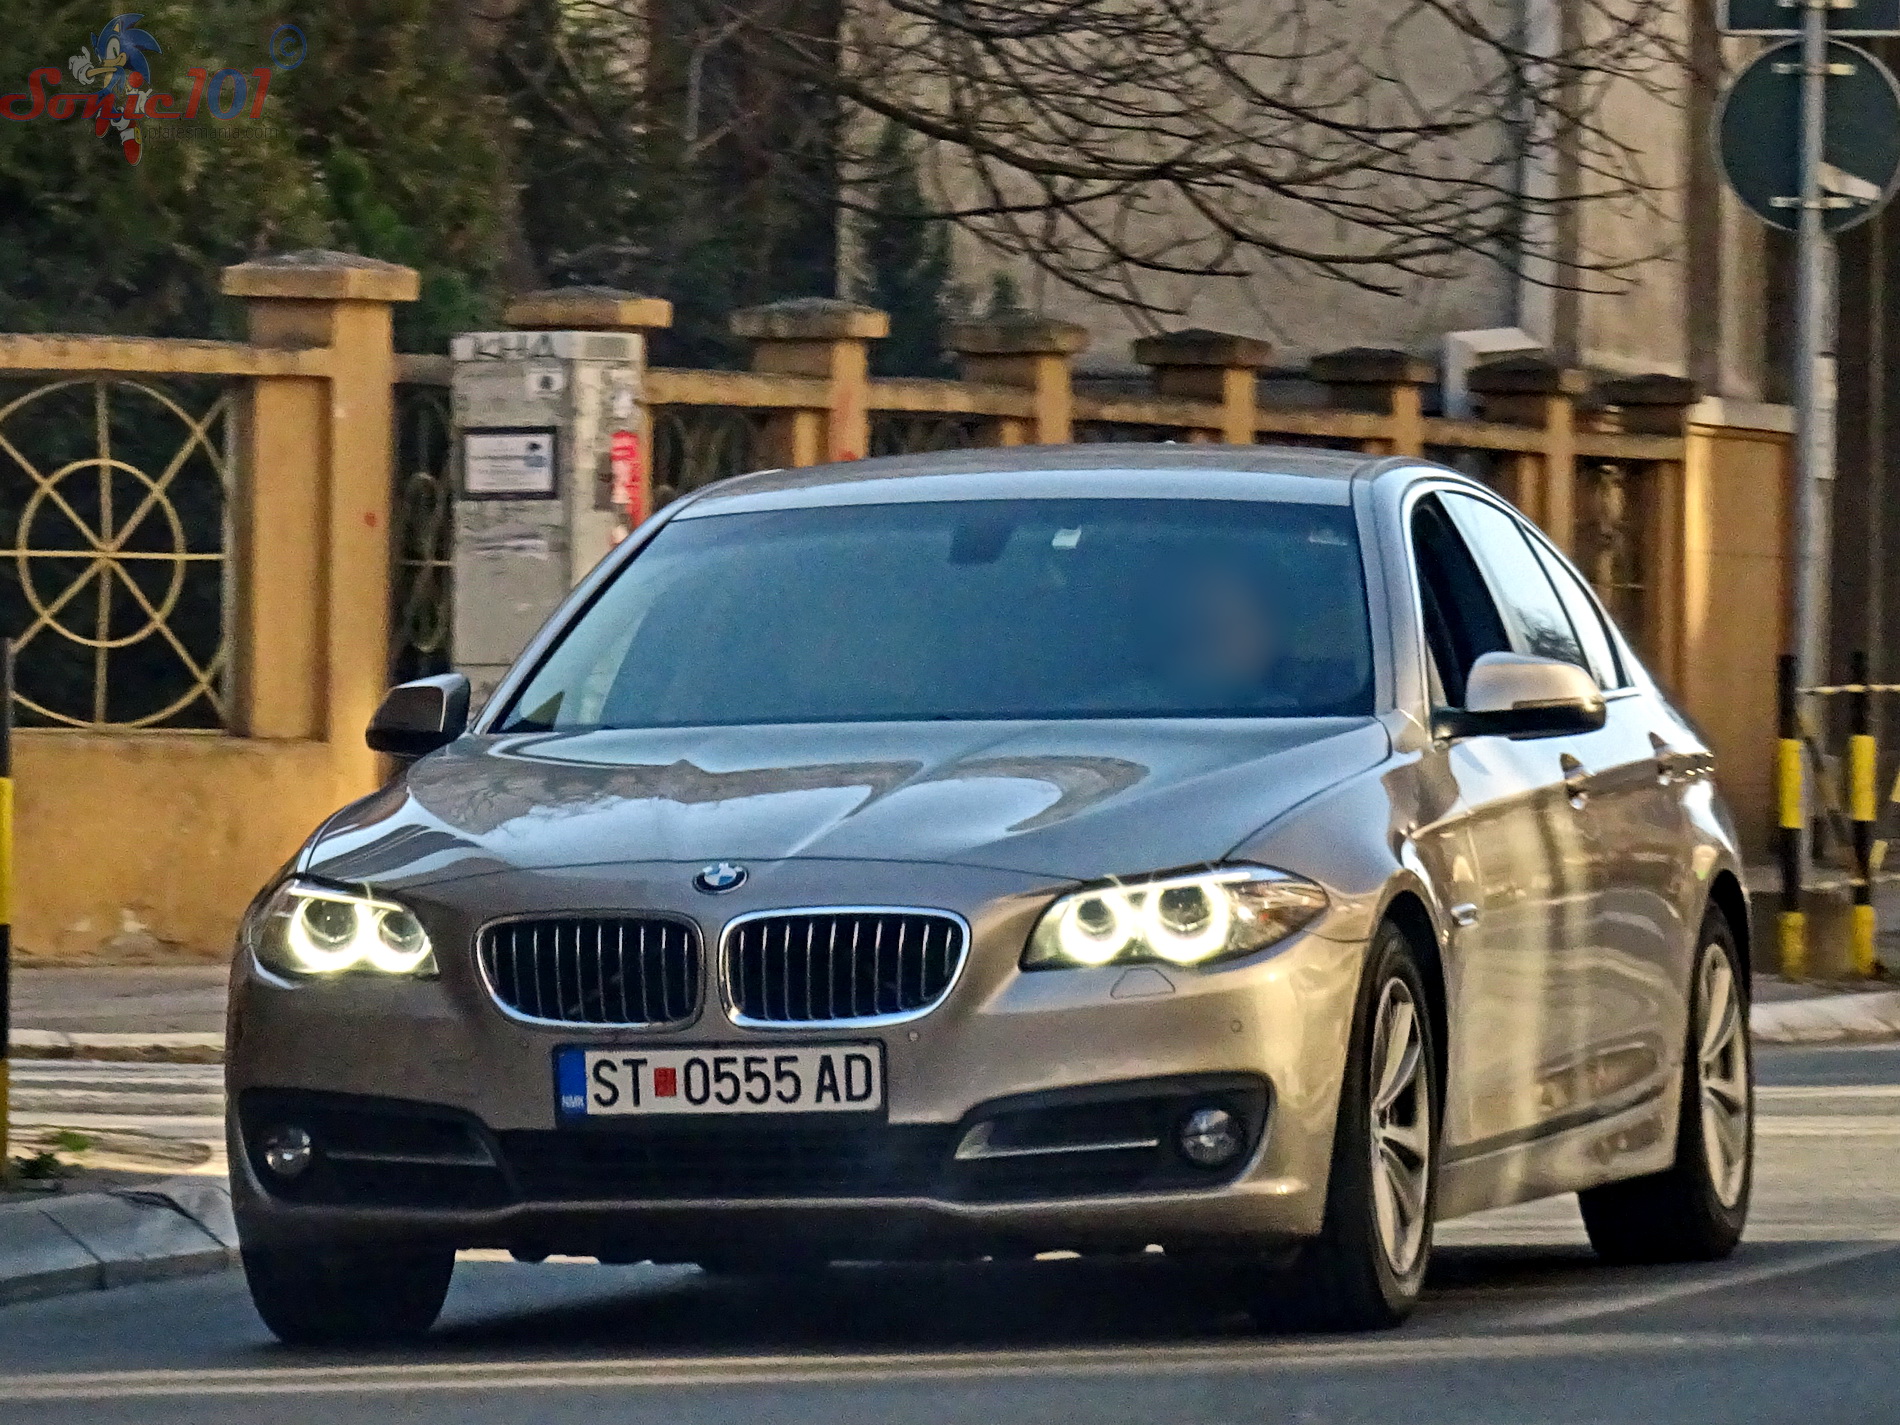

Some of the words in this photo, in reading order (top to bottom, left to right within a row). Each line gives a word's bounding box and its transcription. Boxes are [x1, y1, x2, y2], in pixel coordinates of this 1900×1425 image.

[592, 1058, 648, 1107] ST
[684, 1056, 801, 1106] 0555
[815, 1053, 873, 1104] AD
